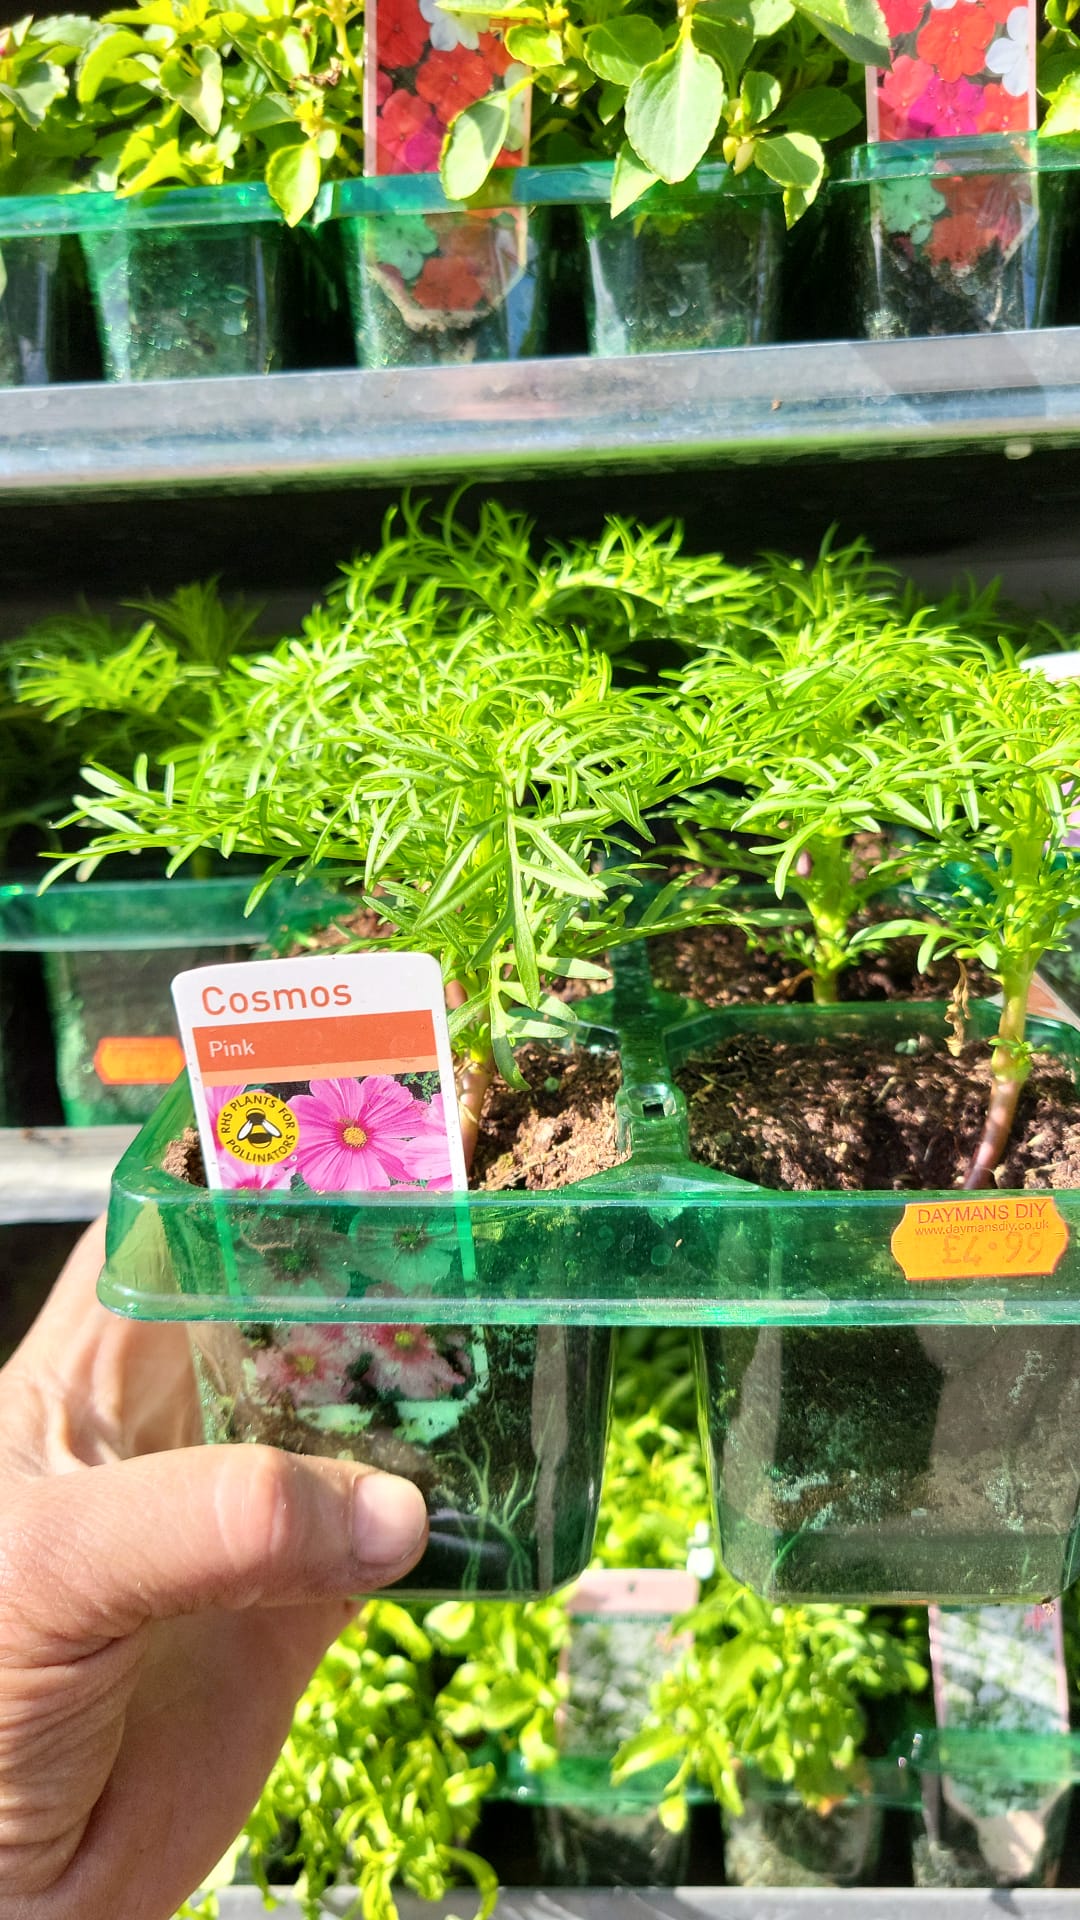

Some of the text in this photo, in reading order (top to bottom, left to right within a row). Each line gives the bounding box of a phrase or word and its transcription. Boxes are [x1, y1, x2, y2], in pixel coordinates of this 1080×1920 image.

[202, 984, 352, 1016] Cosmos
[208, 1039, 256, 1058] Pink
[221, 1094, 296, 1134] RHS PLANTS FOR
[226, 1134, 296, 1163] POLLINATORS
[918, 1202, 1048, 1224] DAYMANS DIY
[915, 1220, 1048, 1235] www.daymansdiy.co.uk
